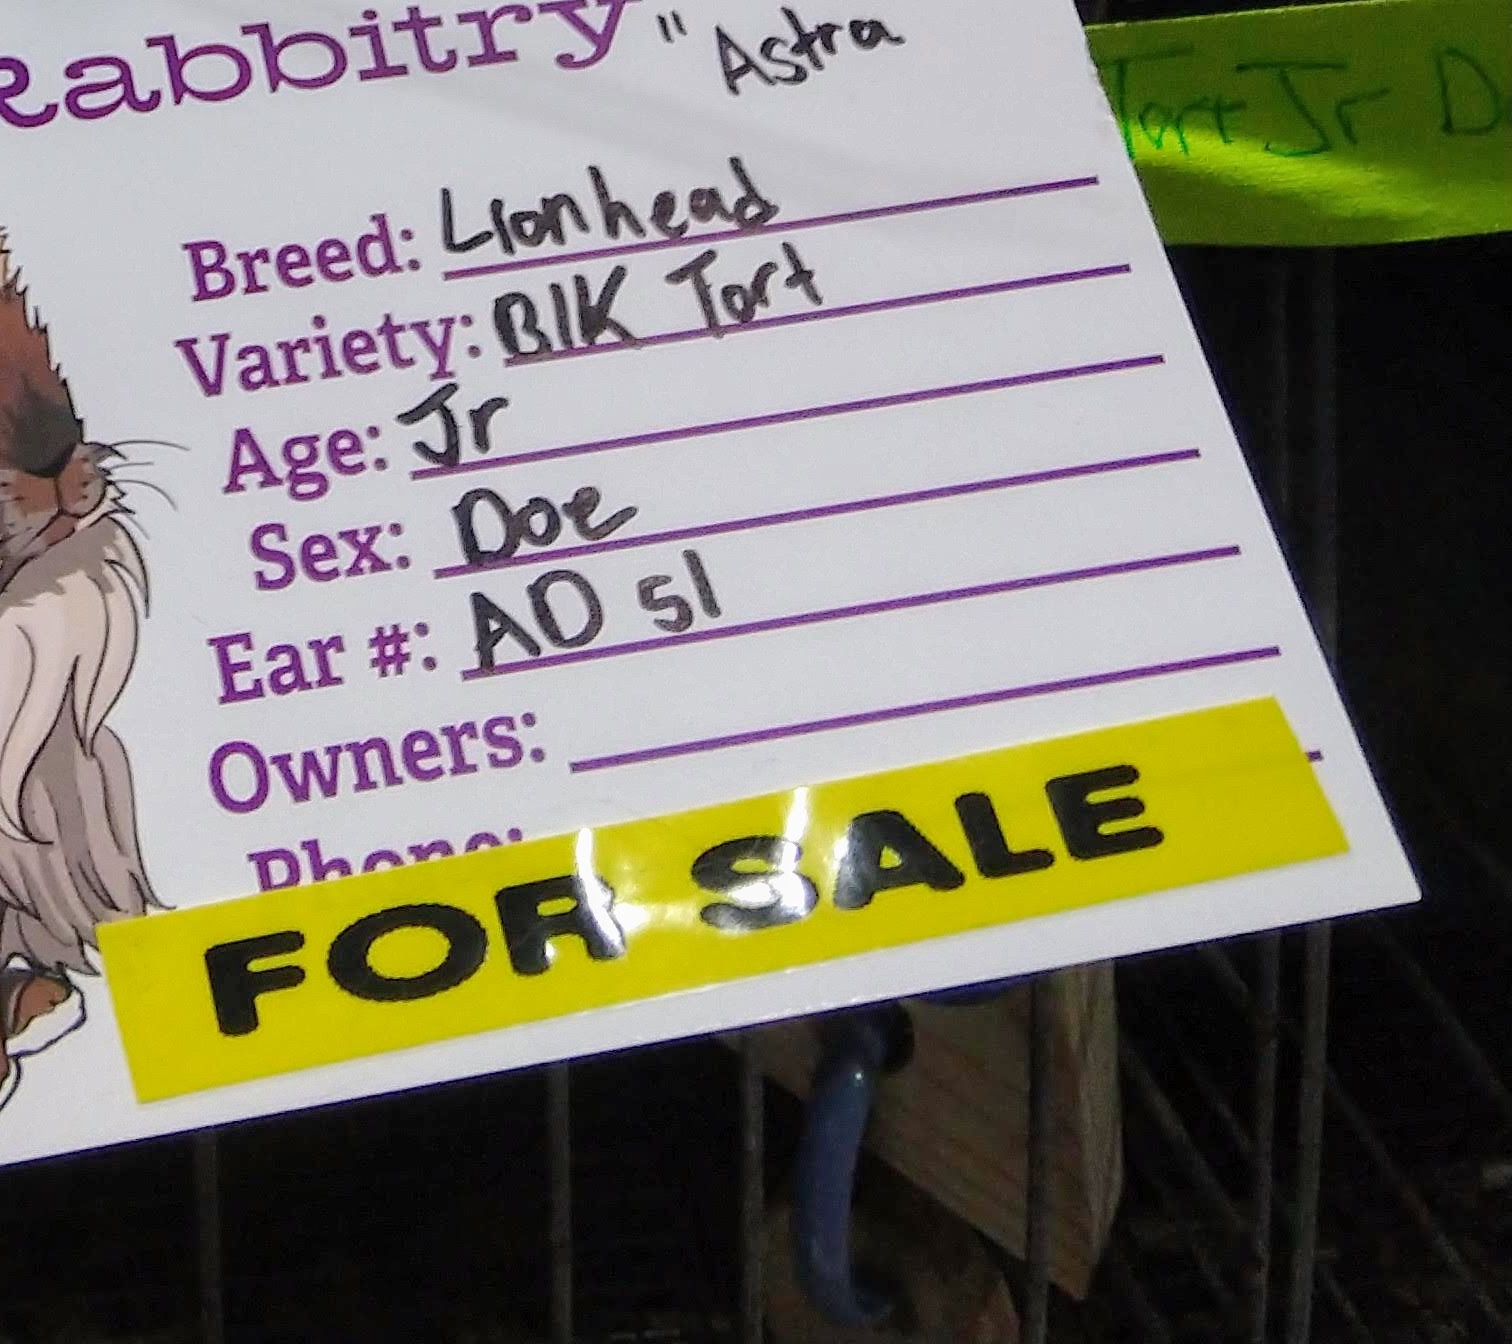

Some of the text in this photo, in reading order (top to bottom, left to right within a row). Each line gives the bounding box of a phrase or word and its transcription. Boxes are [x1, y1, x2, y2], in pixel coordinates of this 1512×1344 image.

[1235, 58, 1388, 158] Jr
[1433, 42, 1512, 138] D
[440, 155, 780, 255] Lionhead
[183, 213, 422, 303] Breed:
[663, 241, 825, 339] Tort
[175, 309, 484, 398] Variety:
[222, 423, 389, 502] Age:
[396, 381, 510, 469] Jr
[248, 521, 412, 592] Sex:
[449, 484, 639, 567] Doe
[205, 619, 438, 705] Ear #:
[207, 711, 546, 814] Owners:
[204, 763, 1166, 1036] FOR SALE
